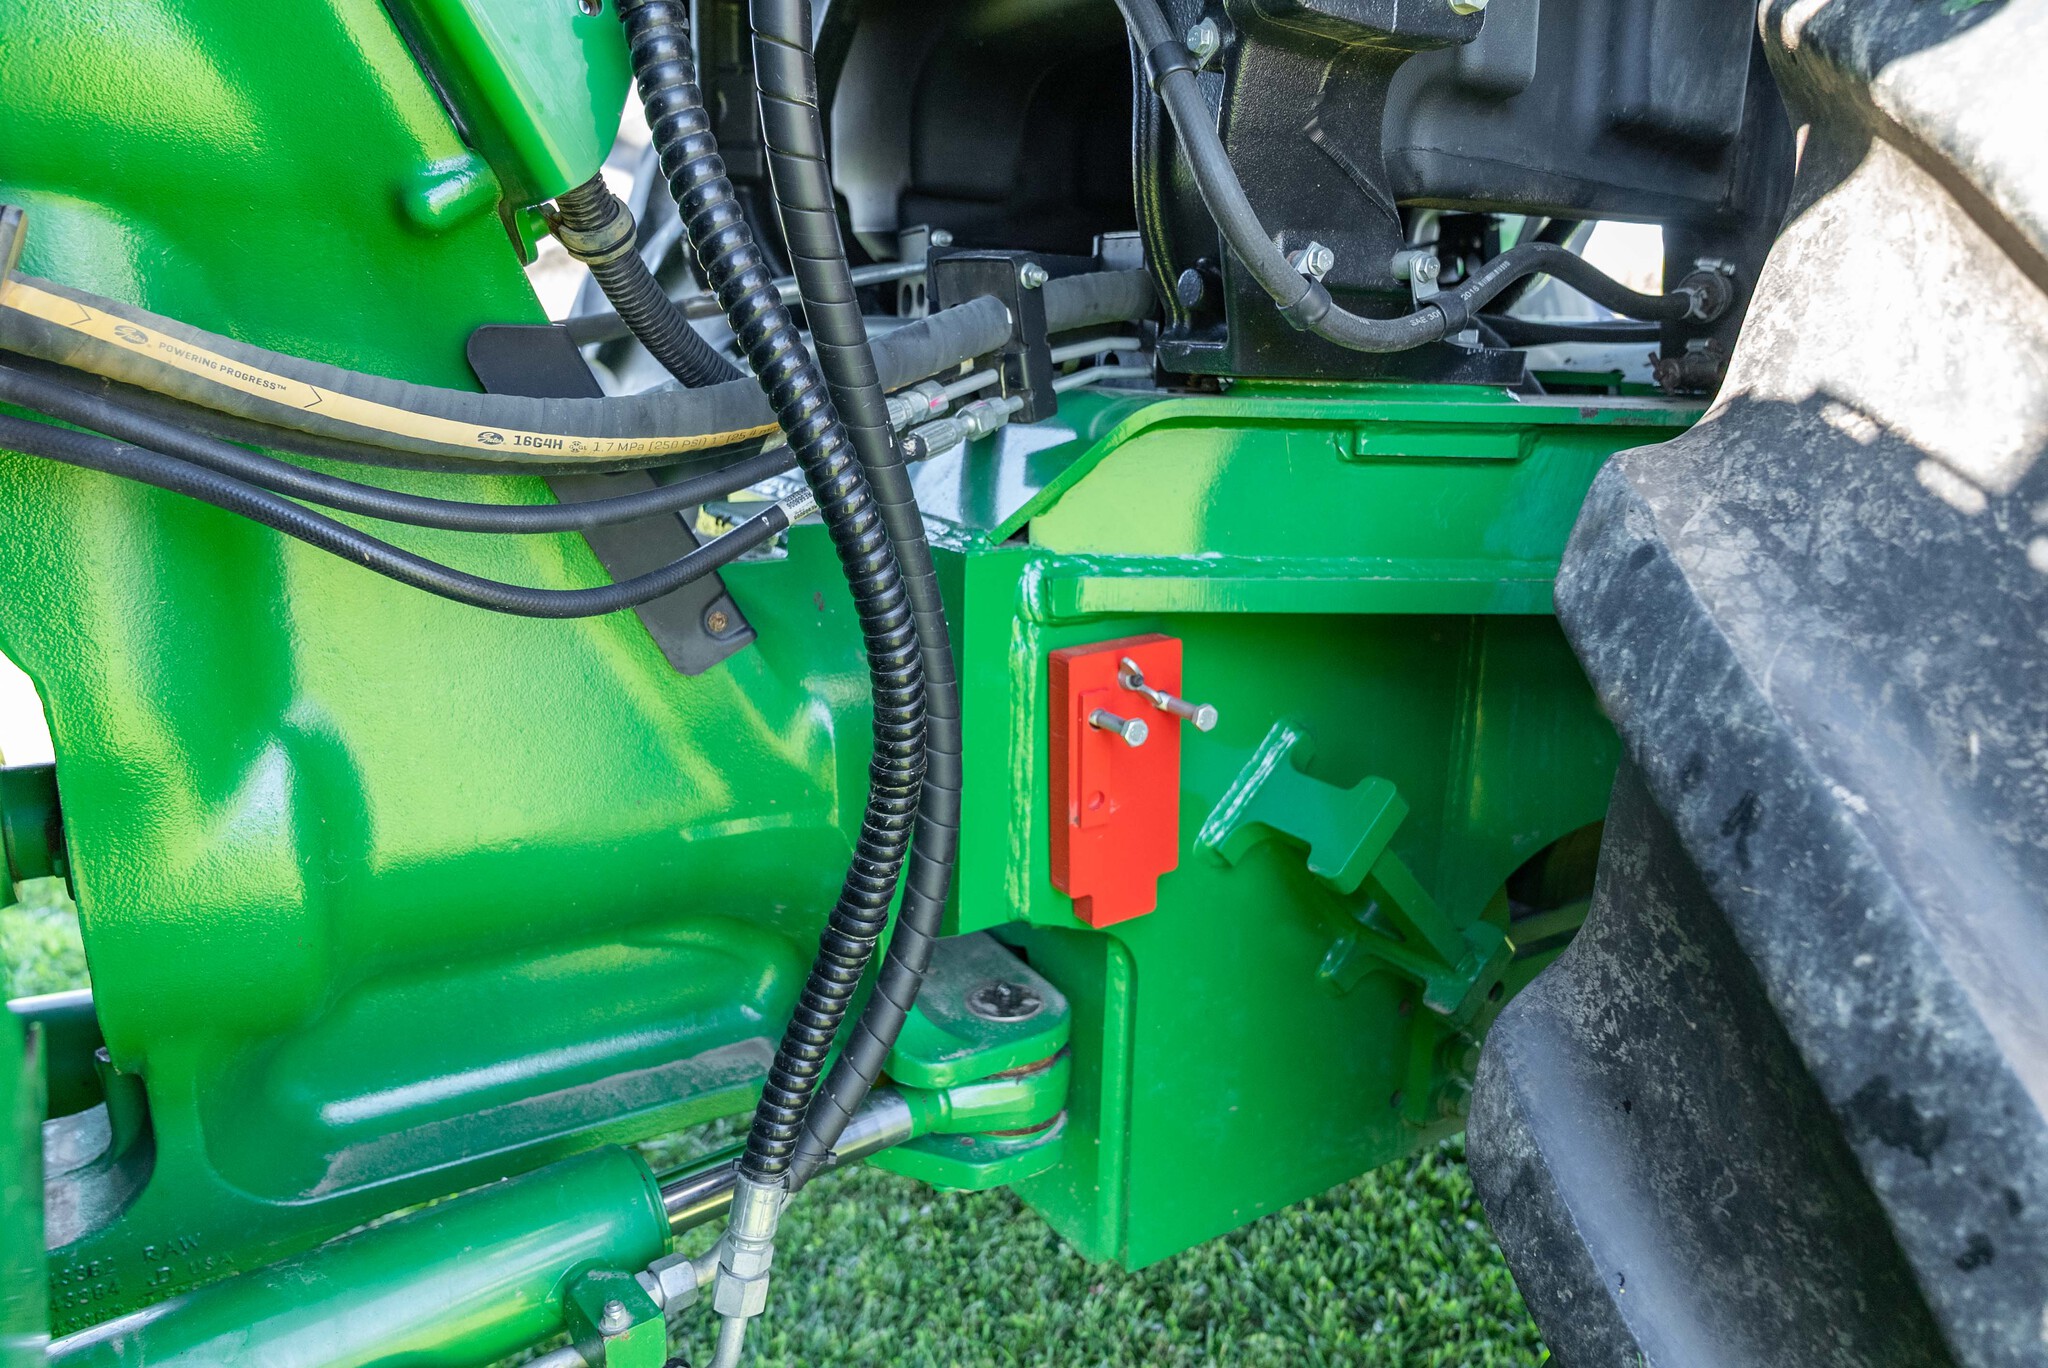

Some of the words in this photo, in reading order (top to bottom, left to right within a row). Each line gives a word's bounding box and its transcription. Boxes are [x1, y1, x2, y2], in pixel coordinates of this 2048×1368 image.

[1410, 315, 1428, 327] SAE
[159, 341, 218, 370] POWERING
[513, 435, 564, 450] 16G4H
[617, 442, 645, 452] MPa
